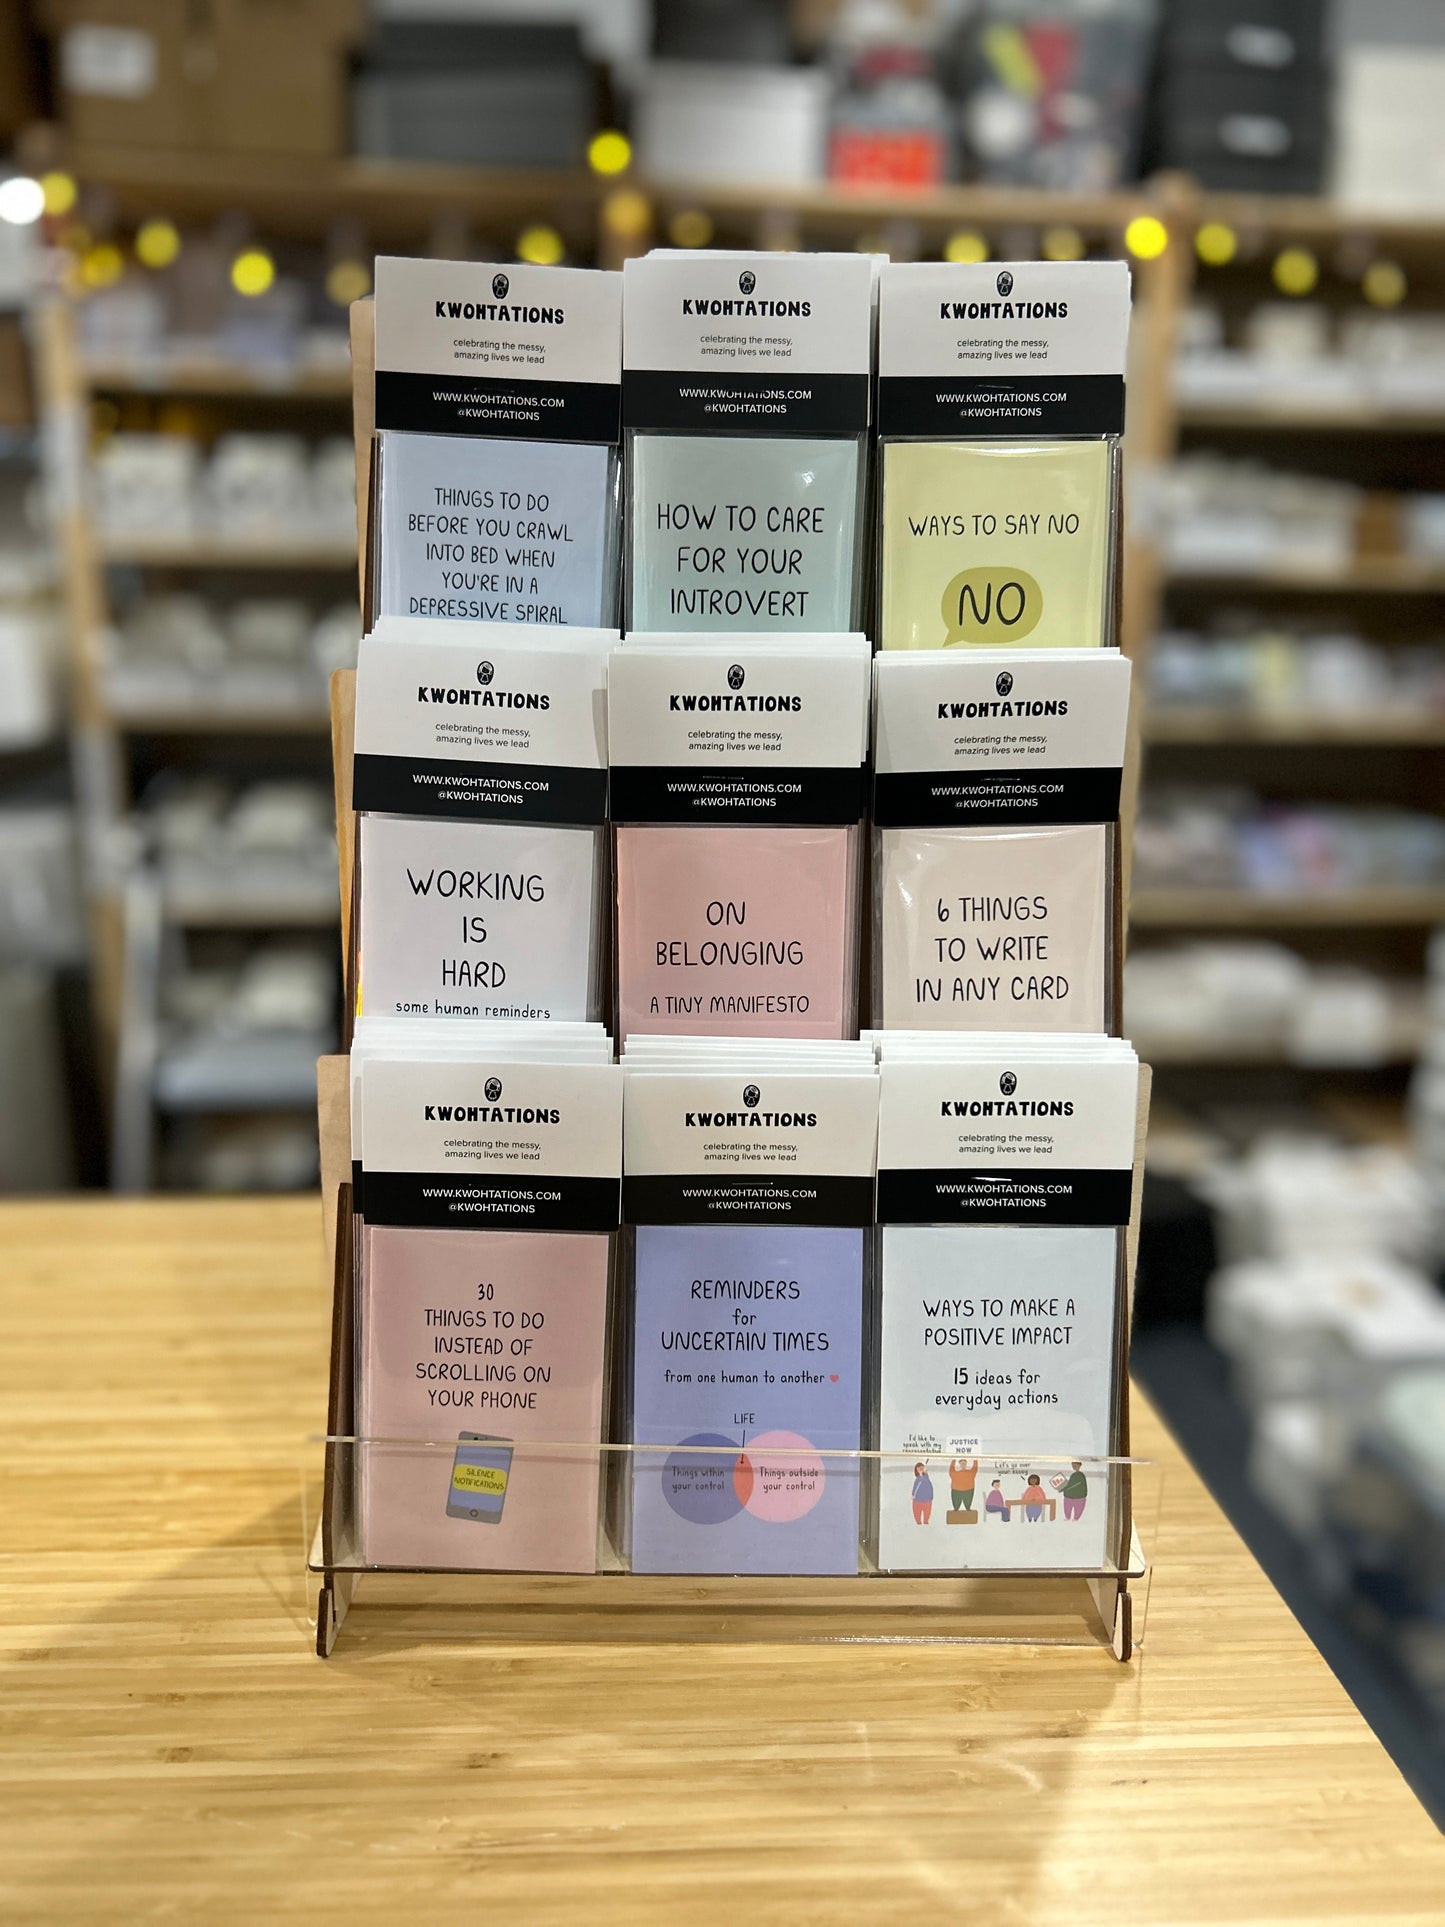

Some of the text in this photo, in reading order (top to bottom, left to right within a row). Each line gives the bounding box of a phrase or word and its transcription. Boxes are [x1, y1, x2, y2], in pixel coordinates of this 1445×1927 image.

[436, 302, 564, 324] KWOHTATIONS
[682, 299, 811, 317] KWOHTATIONS
[941, 302, 1068, 319] KWOHTATIONS
[453, 339, 546, 352] celebrating the messy,
[957, 338, 1049, 350] celebrating the messy,
[454, 351, 488, 362] amazing
[491, 352, 509, 361] lives
[527, 354, 545, 364] lead
[958, 351, 992, 361] amazing
[995, 351, 1012, 359] lives
[1030, 351, 1047, 359] lead
[433, 392, 564, 408] WWW.KWOHTATIONS.COM
[936, 393, 1067, 403] WWW.KWOHTATIONS.COM
[458, 409, 540, 421] @KWOHTATIONS
[704, 403, 787, 414] @KWOHTATIONS
[960, 407, 1042, 417] @KWOHTATIONS
[435, 488, 549, 511] THINGS TO DO
[658, 503, 825, 533] HOW TO CARE
[909, 514, 1079, 537] WAYS TO SAY NO
[409, 515, 573, 541] BEFORE YOU CRAWL
[426, 544, 555, 568] INTO BED WHEN
[678, 546, 802, 574] FOR YOUR
[441, 572, 538, 594] YOU'RE IN A
[409, 598, 568, 624] DEPRESSIVE SPIRAL
[671, 588, 809, 617] INTROVERT
[959, 582, 1025, 625] NO
[418, 687, 550, 710] KWOHTATIONS
[670, 695, 801, 712] KWOHTATIONS
[938, 701, 1068, 719] KWOHTATIONS
[688, 730, 782, 742] celebrating the messy,
[689, 743, 724, 752] amazing
[727, 742, 745, 751] lives
[763, 743, 781, 751] lead
[413, 775, 549, 791] WWW.KWOHTATIONS.COM
[667, 783, 801, 793] WWW.KWOHTATIONS.COM
[931, 784, 1064, 796] WWW.KWOHTATIONS.COM
[438, 791, 523, 804] @KWOHTATIONS
[693, 797, 777, 807] @KWOHTATIONS
[955, 798, 1038, 809] @KWOHTATIONS
[407, 868, 544, 902] WORKING
[706, 902, 745, 925] ON
[938, 896, 1047, 922] 6 THINGS
[463, 916, 487, 943] IS
[657, 941, 804, 966] BELONGING
[934, 936, 1048, 962] TO WRITE
[442, 959, 506, 988] HARD
[916, 976, 1069, 1003] IN ANY CARD
[396, 1000, 550, 1019] some human reminders
[651, 995, 809, 1014] A TINY MANIFESTO
[425, 1106, 560, 1124] KWOHTATIONS
[941, 1101, 1074, 1116] KWOHTATIONS
[685, 1113, 817, 1127] KWOHTATIONS
[959, 1134, 1006, 1143] celebrating
[1025, 1136, 1054, 1144] messy,
[959, 1145, 995, 1154] amazing
[997, 1145, 1016, 1153] lives
[1034, 1145, 1052, 1153] lead
[423, 1189, 561, 1201] WWW.KWOHTATIONS.COM
[682, 1189, 817, 1198] WWW.KWOHTATIONS.COM
[936, 1185, 1073, 1194] WWW.KWOHTATIONS.COM
[449, 1202, 535, 1213] @KWOHTATIONS
[708, 1201, 791, 1211] @KWOHTATIONS
[961, 1198, 1046, 1207] @KWOHTATIONS
[477, 1284, 494, 1301] 30
[691, 1280, 800, 1300] REMINDERS
[923, 1299, 1075, 1317] WAYS TO MAKE A
[424, 1309, 545, 1329] THINGS TO DO
[732, 1309, 757, 1326] for
[662, 1332, 829, 1351] UNCERTAIN TIMES
[924, 1327, 1073, 1346] POSITIVE IMPACT
[434, 1336, 534, 1356] INSTEAD OF
[416, 1363, 551, 1382] SCROLLING ON
[664, 1369, 825, 1383] from one human to another
[954, 1368, 1041, 1385] 15 ideas for
[428, 1389, 537, 1409] YOUR PHONE
[935, 1392, 1058, 1410] everyday actions
[734, 1413, 755, 1424] LIFE
[467, 1468, 496, 1478] SILENCE
[672, 1467, 725, 1479] Things within
[760, 1467, 819, 1479] Things outside
[454, 1477, 504, 1490] NOTIFICATIONS
[672, 1482, 725, 1493] your control
[763, 1482, 815, 1493] your control
